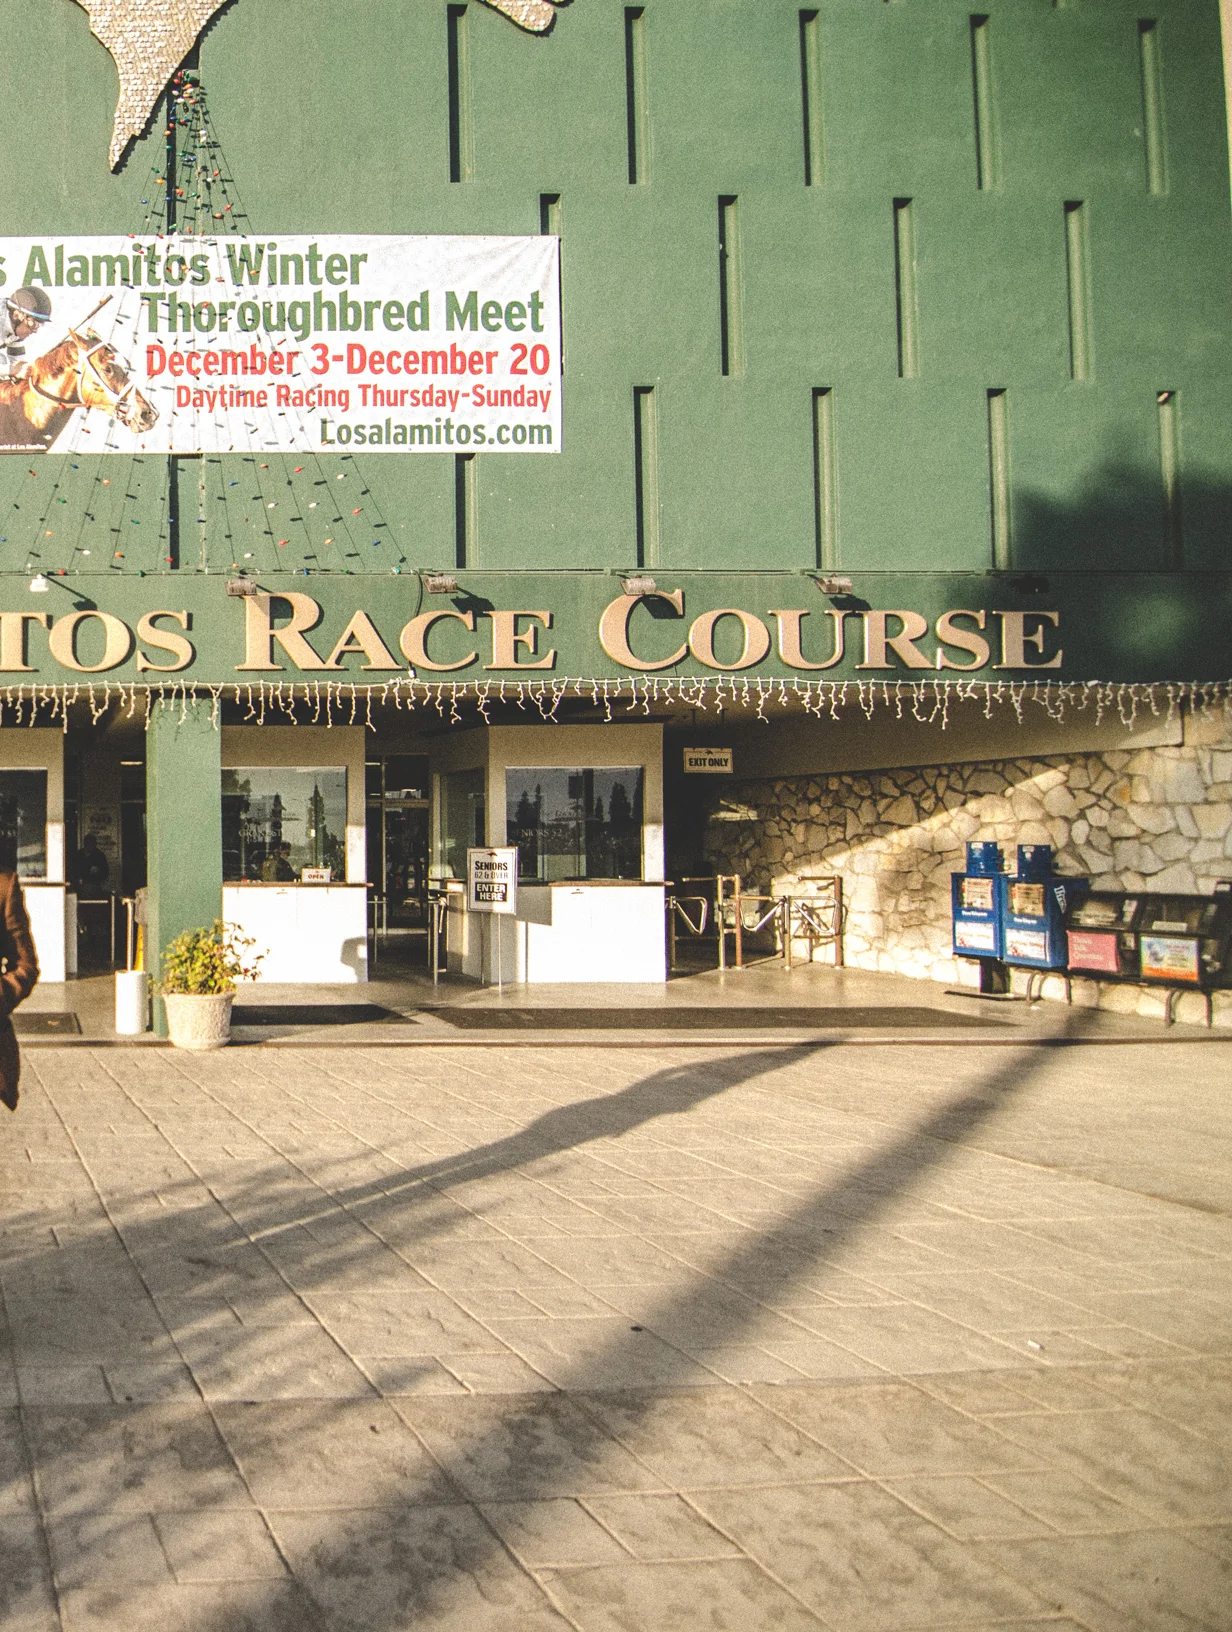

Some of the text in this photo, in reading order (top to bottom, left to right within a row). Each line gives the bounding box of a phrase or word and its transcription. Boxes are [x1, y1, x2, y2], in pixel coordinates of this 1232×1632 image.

[22, 243, 211, 289] Alamitos
[225, 242, 368, 286] Winter
[140, 289, 545, 343] Thoroughbred Meet
[145, 343, 551, 377] December 3-December 20
[176, 383, 552, 413] Daytime Racing Thursday-Sunday
[320, 416, 553, 447] Losalamitos.com
[234, 591, 558, 673] RACE
[597, 588, 1066, 673] COURSE
[688, 757, 729, 767] EXIT ONLY
[474, 860, 509, 871] SENIORS
[474, 870, 483, 879] 62
[476, 883, 506, 892] ENTER
[479, 892, 504, 901] HERE
